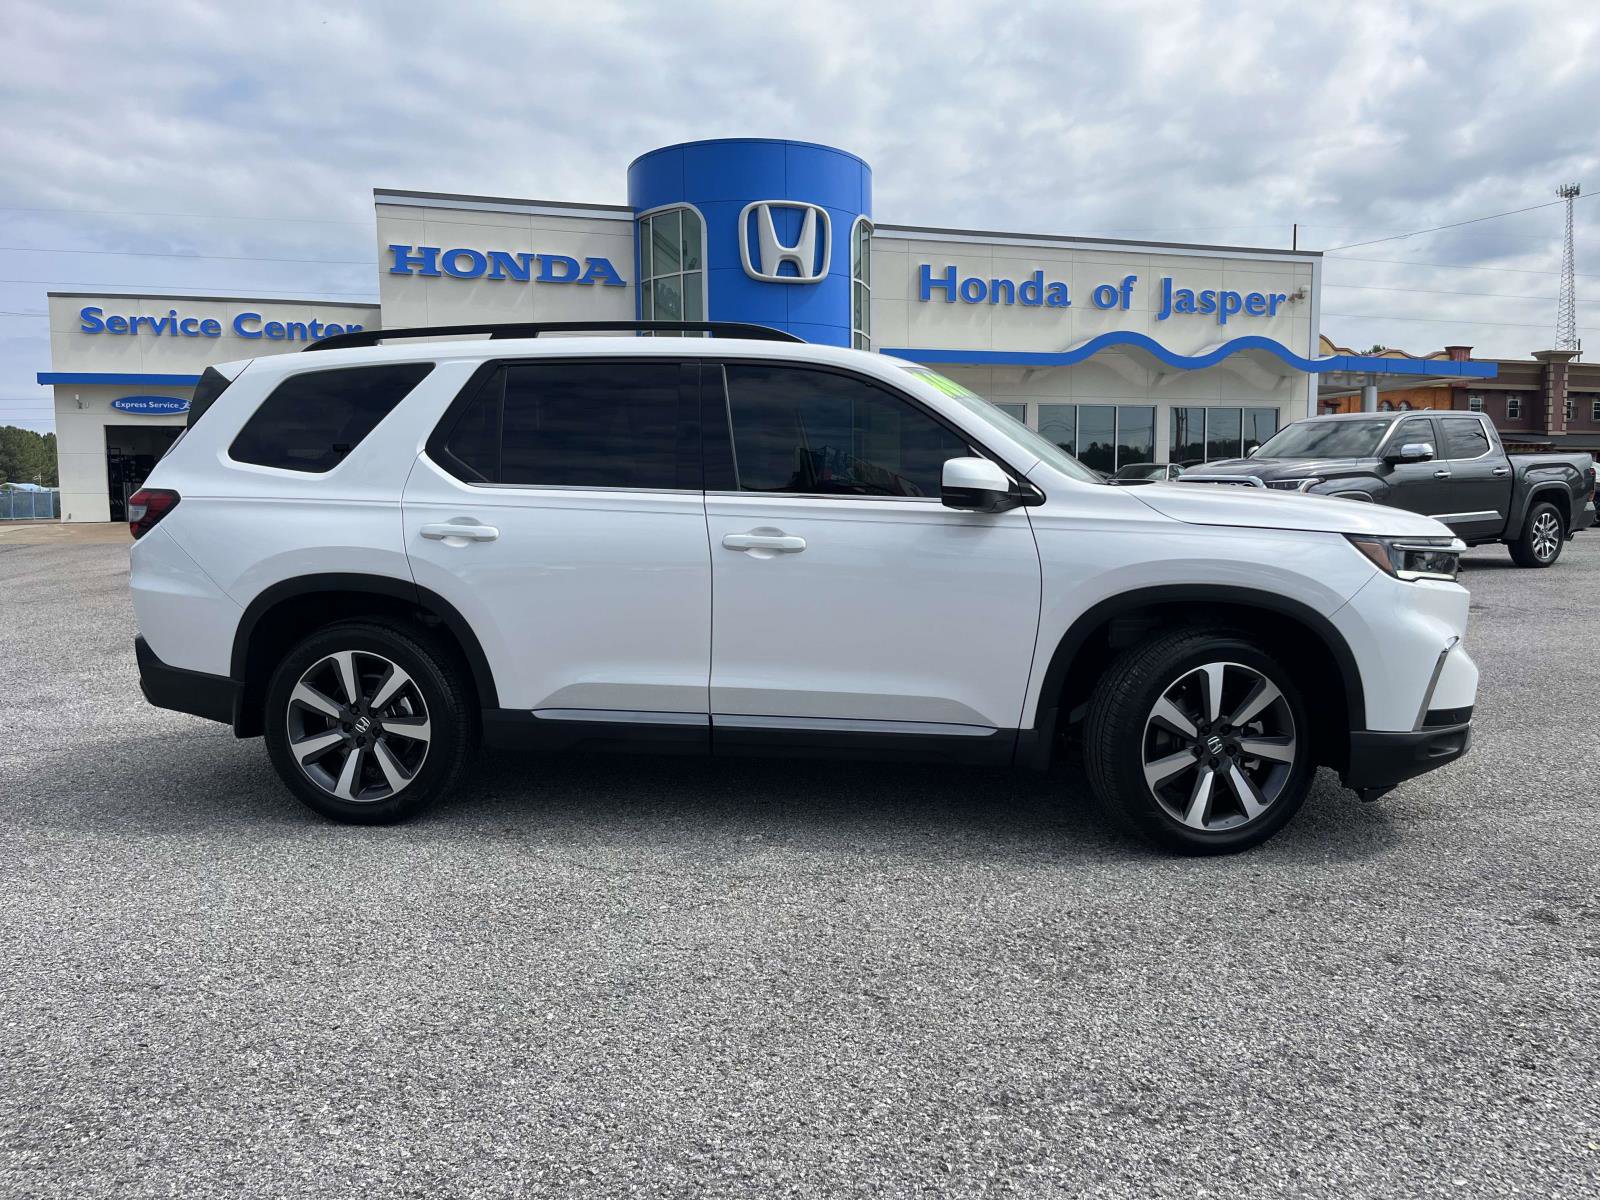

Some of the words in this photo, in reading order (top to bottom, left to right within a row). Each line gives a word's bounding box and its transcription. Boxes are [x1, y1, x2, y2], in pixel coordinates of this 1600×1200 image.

[389, 245, 627, 286] HONDA
[919, 264, 1072, 307] Honda
[1093, 275, 1137, 310] of
[1157, 278, 1287, 325] Jasper
[80, 306, 222, 337] Service
[115, 401, 147, 409] Express
[148, 401, 179, 409] Service
